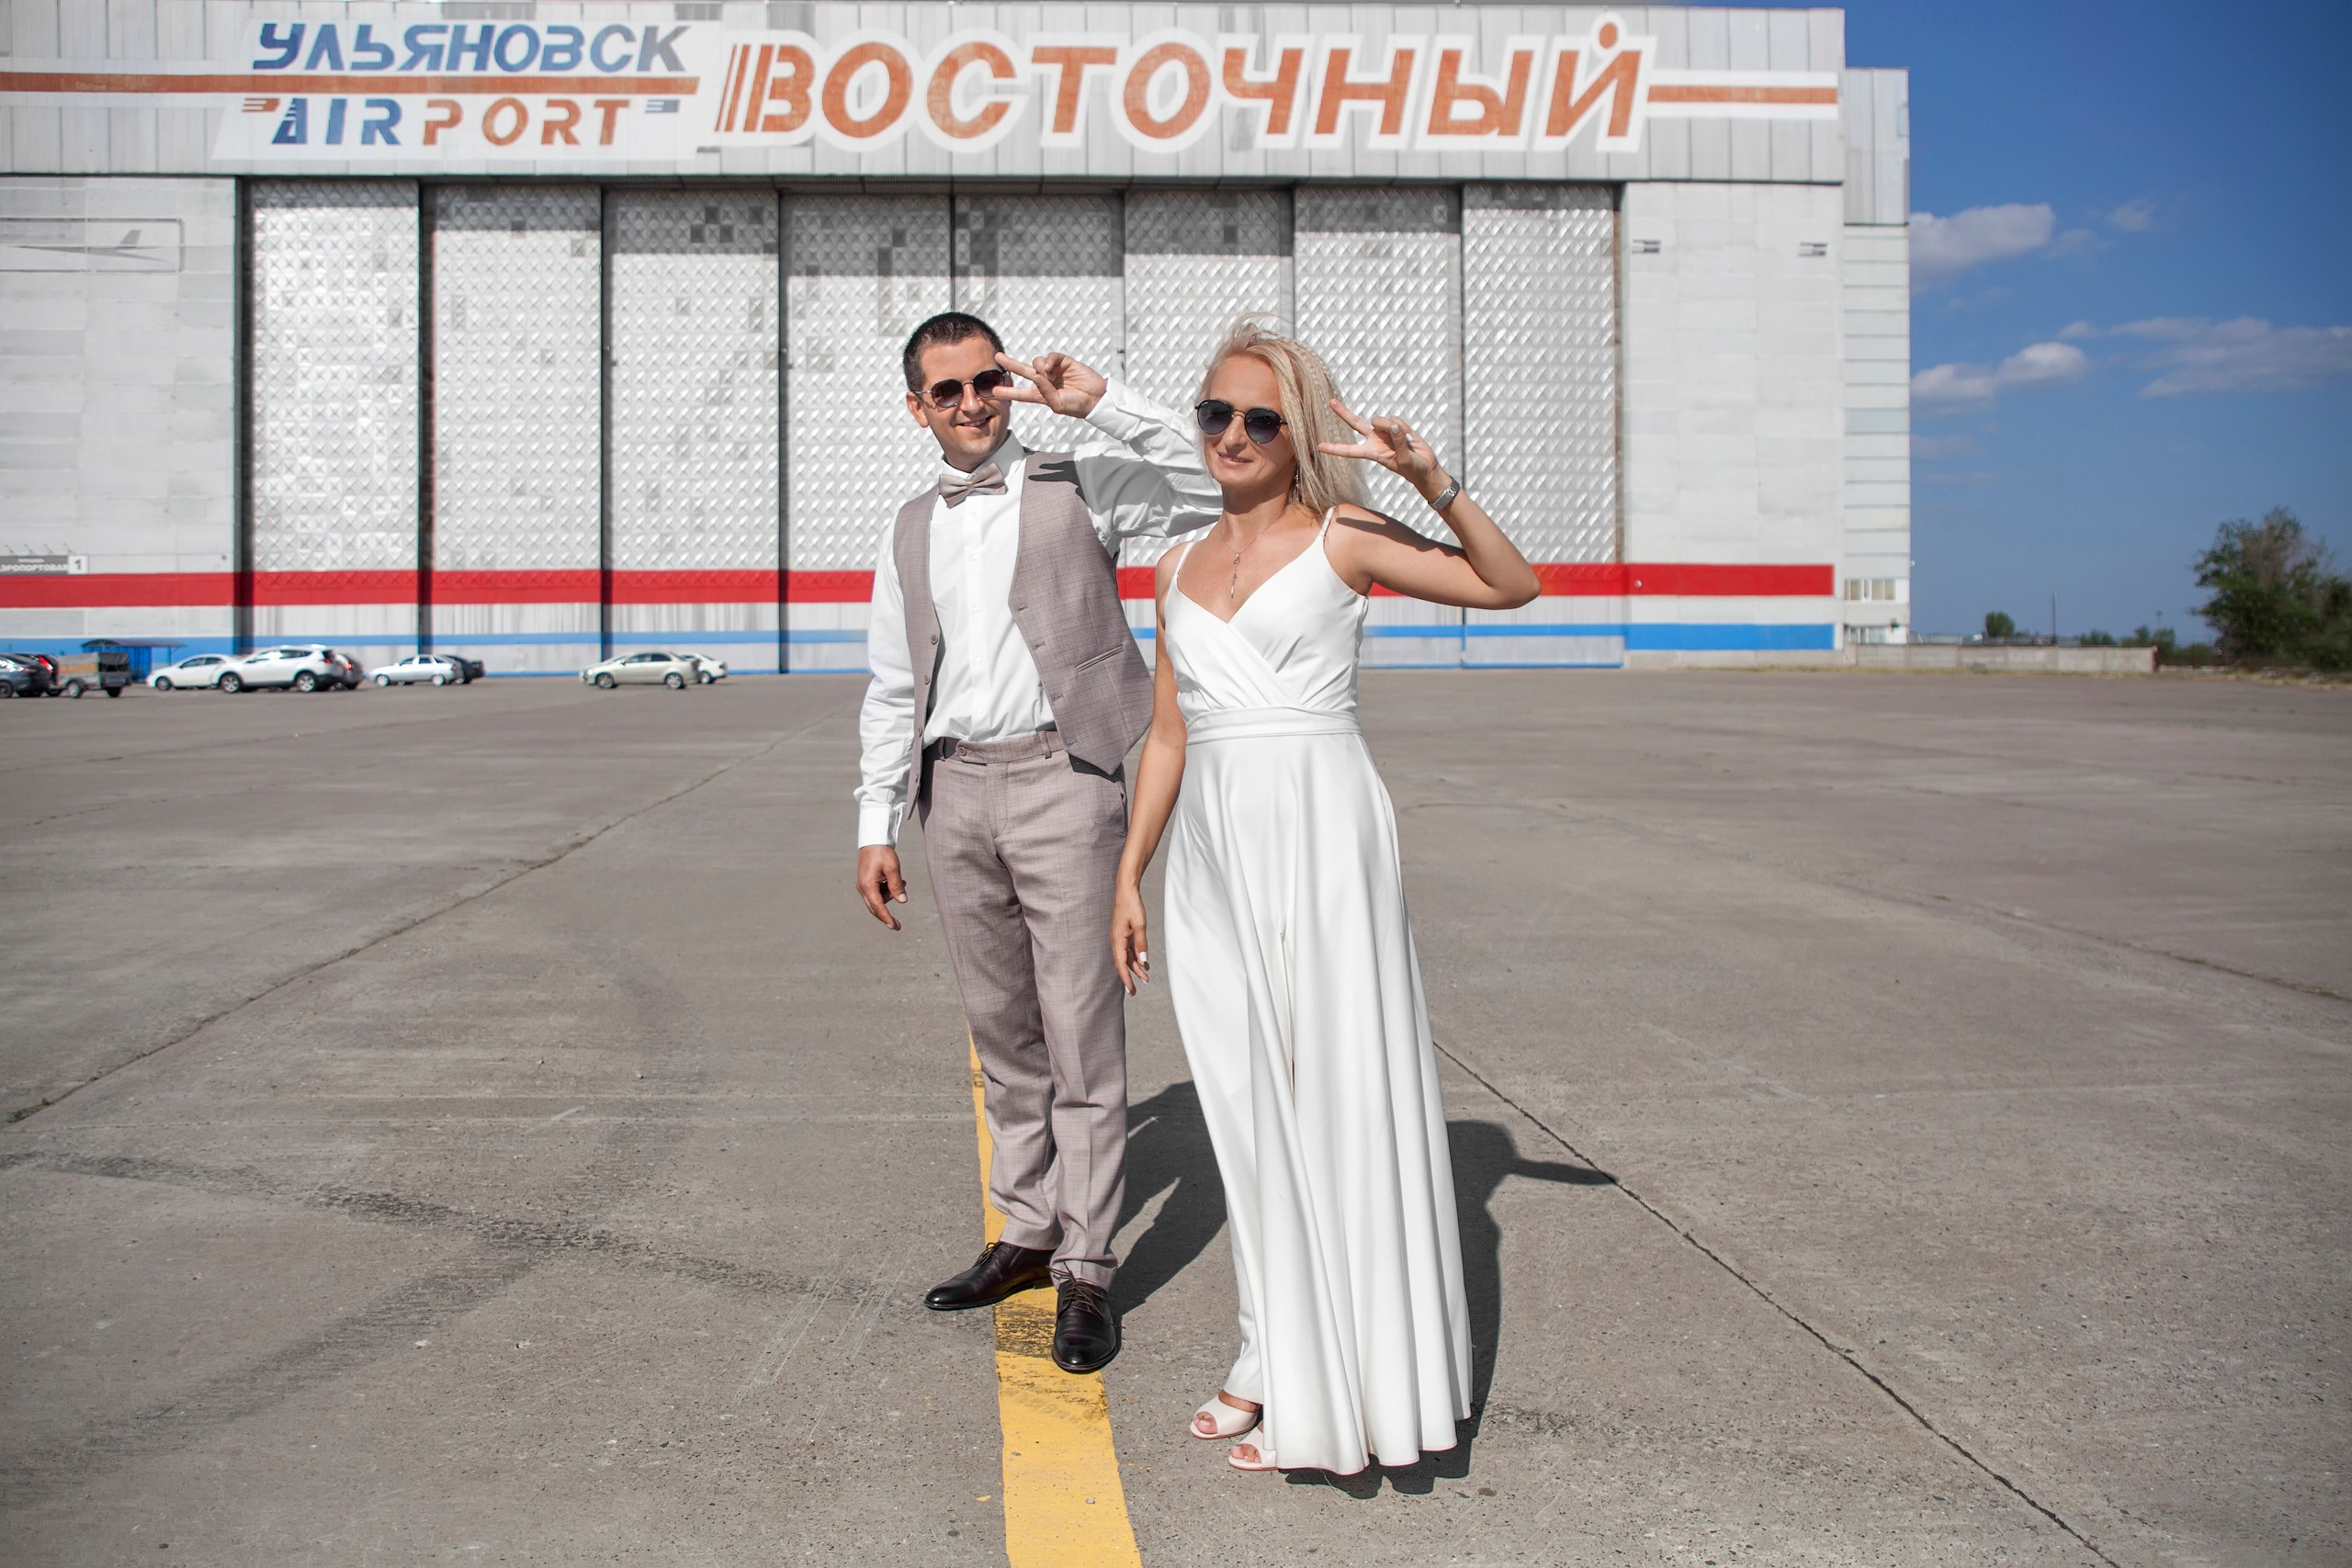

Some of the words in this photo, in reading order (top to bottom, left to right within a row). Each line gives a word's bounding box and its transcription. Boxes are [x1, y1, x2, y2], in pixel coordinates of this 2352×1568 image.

[253, 22, 690, 73] УЛЬЯНОВСК
[715, 21, 1642, 140] ВОСТОЧНЫЙ
[271, 97, 630, 146] AIRPORT
[74, 558, 82, 570] 1
